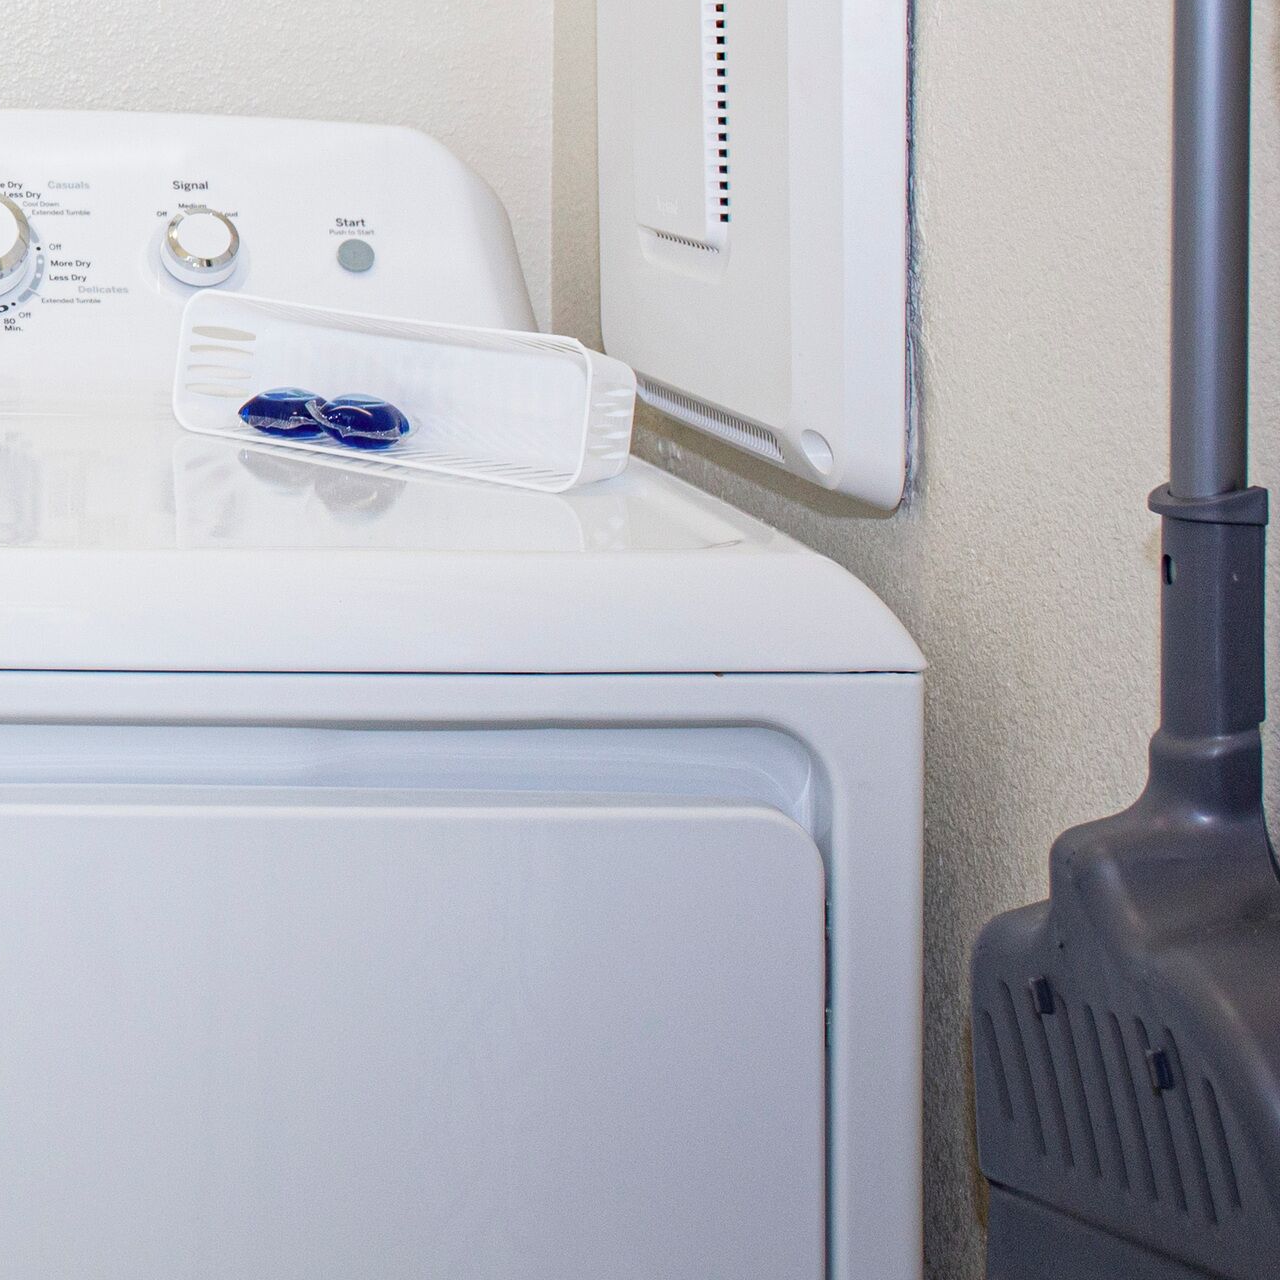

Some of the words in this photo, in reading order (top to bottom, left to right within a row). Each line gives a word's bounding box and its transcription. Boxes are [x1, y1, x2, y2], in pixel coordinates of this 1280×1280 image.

[8, 181, 22, 189] Dry
[48, 181, 90, 189] Casuals
[173, 181, 208, 191] Signal
[336, 218, 365, 227] Start
[76, 260, 91, 268] Dry
[71, 274, 87, 282] Dry
